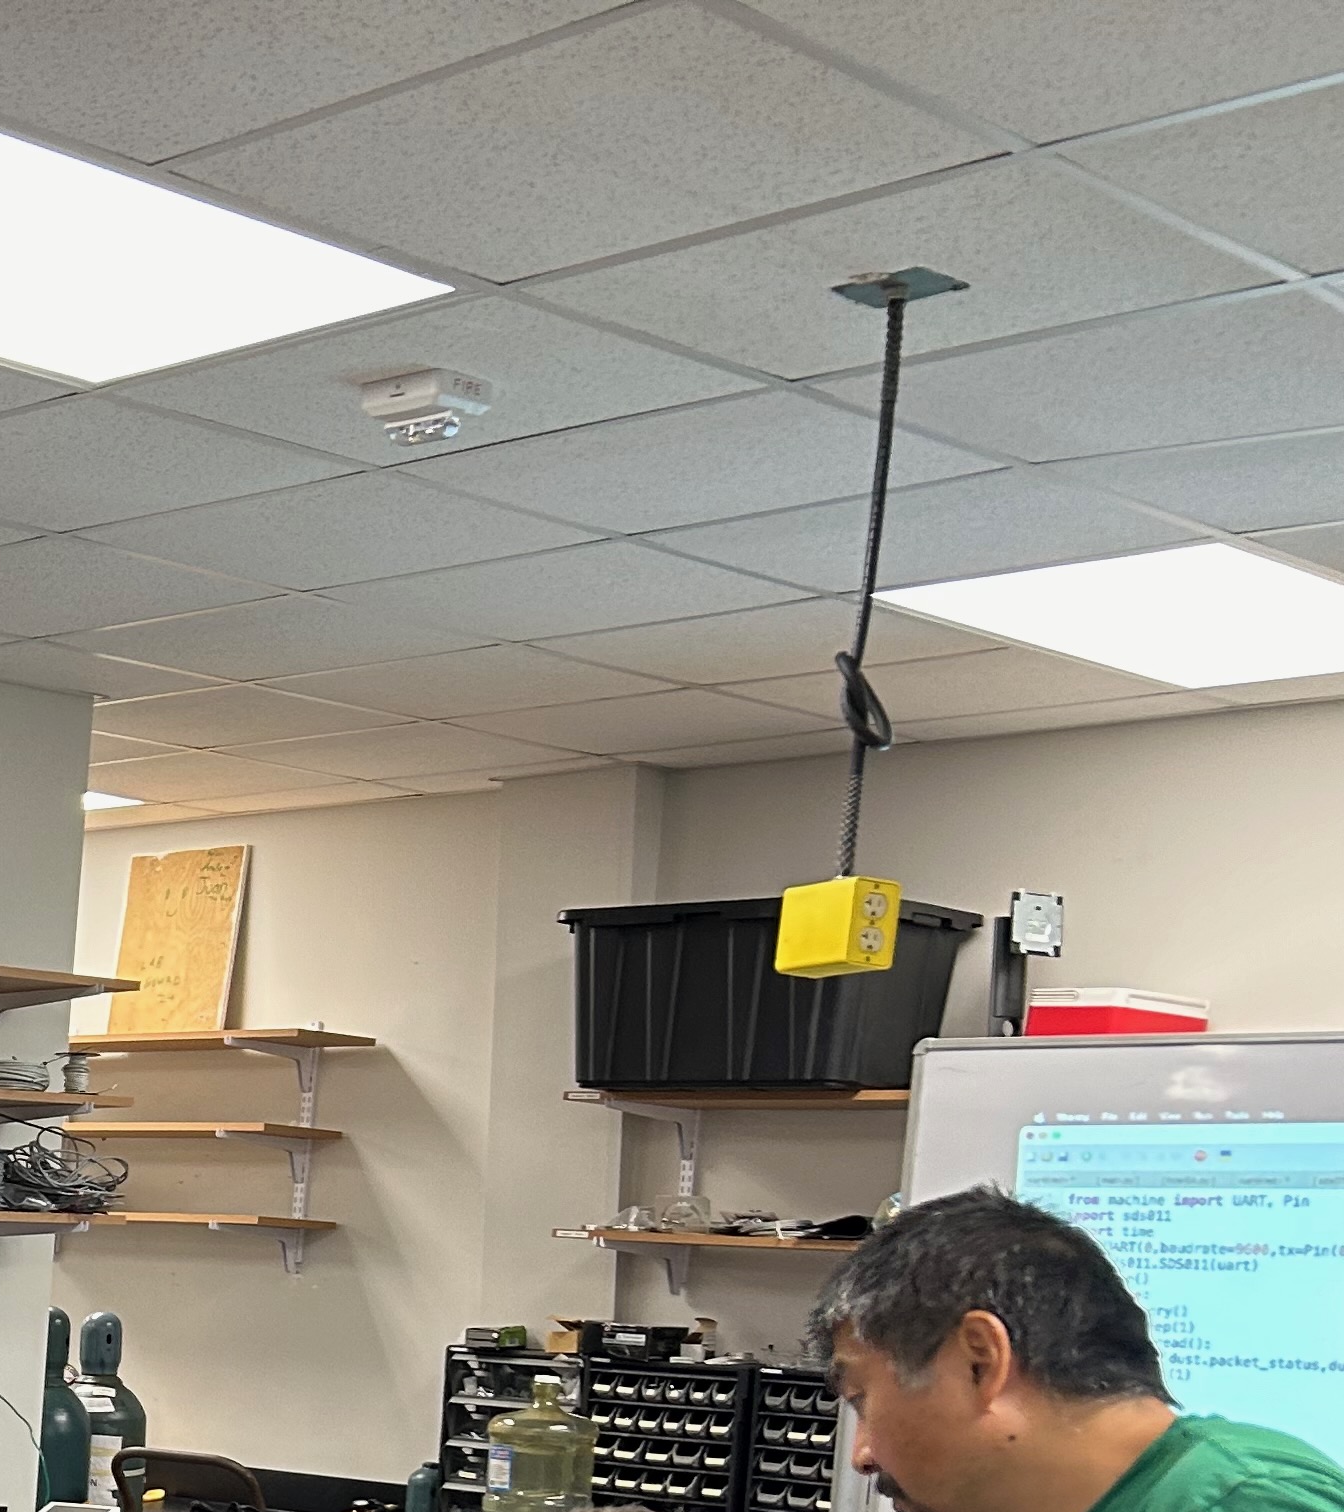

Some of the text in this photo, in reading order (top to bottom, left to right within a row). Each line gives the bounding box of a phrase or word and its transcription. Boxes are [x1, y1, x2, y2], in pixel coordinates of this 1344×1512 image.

[1068, 1193, 1100, 1205] from
[1174, 1194, 1224, 1208] import
[1283, 1194, 1310, 1207] Pin
